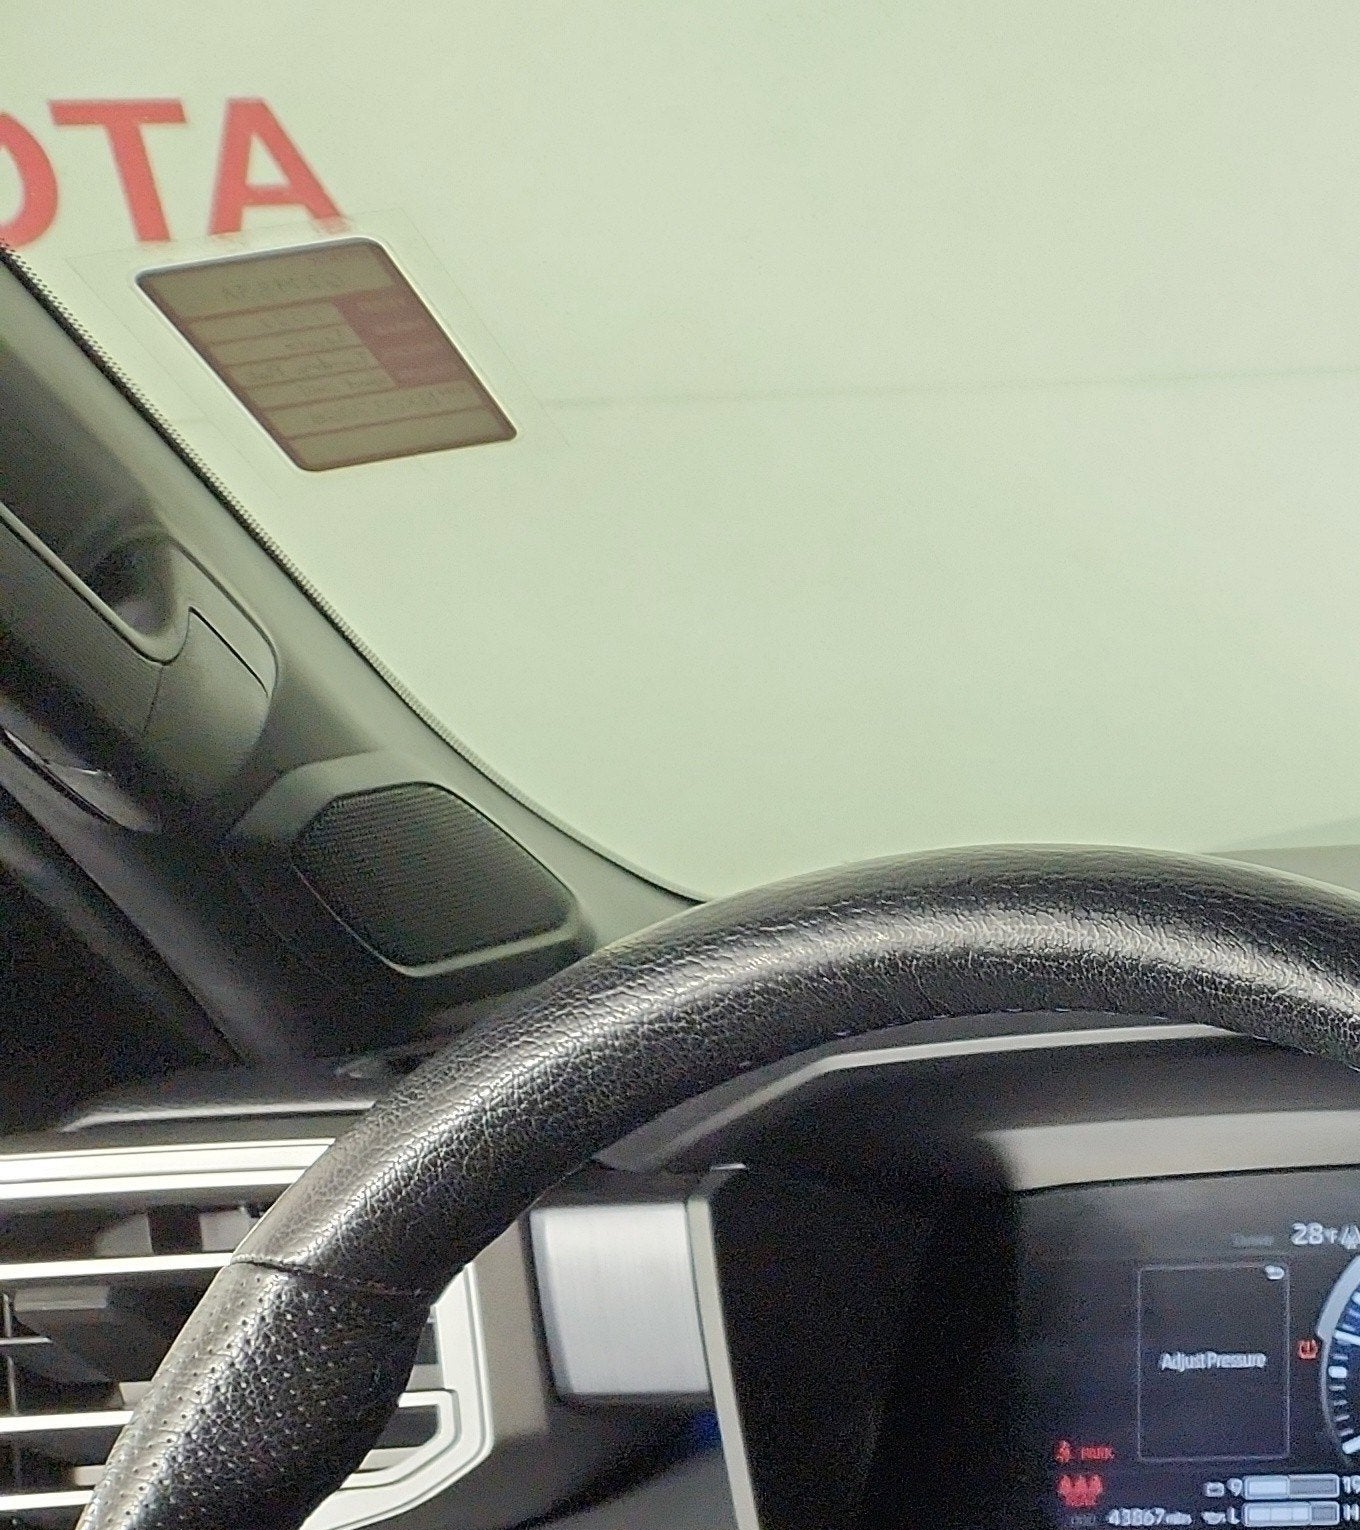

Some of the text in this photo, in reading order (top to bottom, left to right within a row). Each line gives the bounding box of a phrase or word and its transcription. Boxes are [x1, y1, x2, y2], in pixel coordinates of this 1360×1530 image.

[1160, 1350, 1266, 1373] Adjust Pressure
[1226, 1477, 1243, 1497] 9
[1227, 1506, 1241, 1525] L
[1342, 1503, 1360, 1521] H
